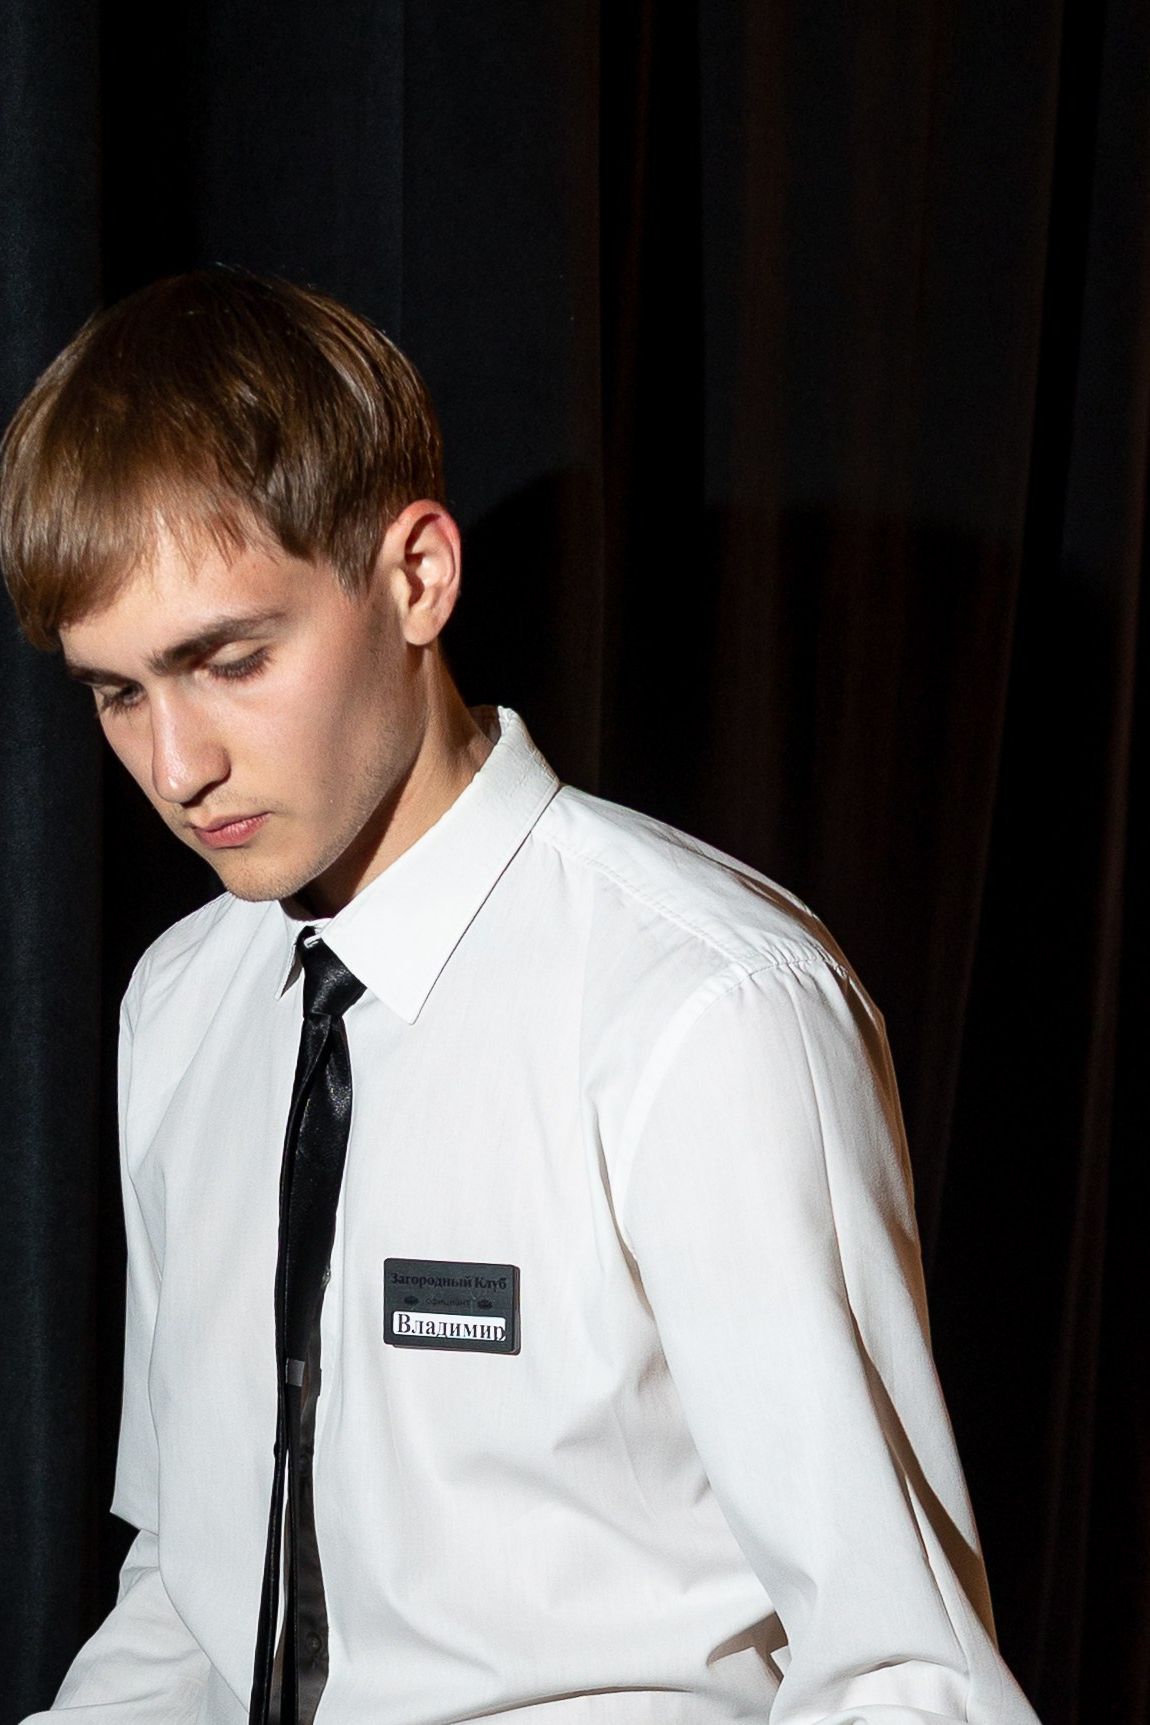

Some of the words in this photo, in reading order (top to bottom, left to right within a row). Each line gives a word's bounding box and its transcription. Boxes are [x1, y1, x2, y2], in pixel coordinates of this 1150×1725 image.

[391, 1272, 472, 1289] Загородный
[475, 1276, 508, 1292] Клуб
[397, 1313, 506, 1342] Владимир
